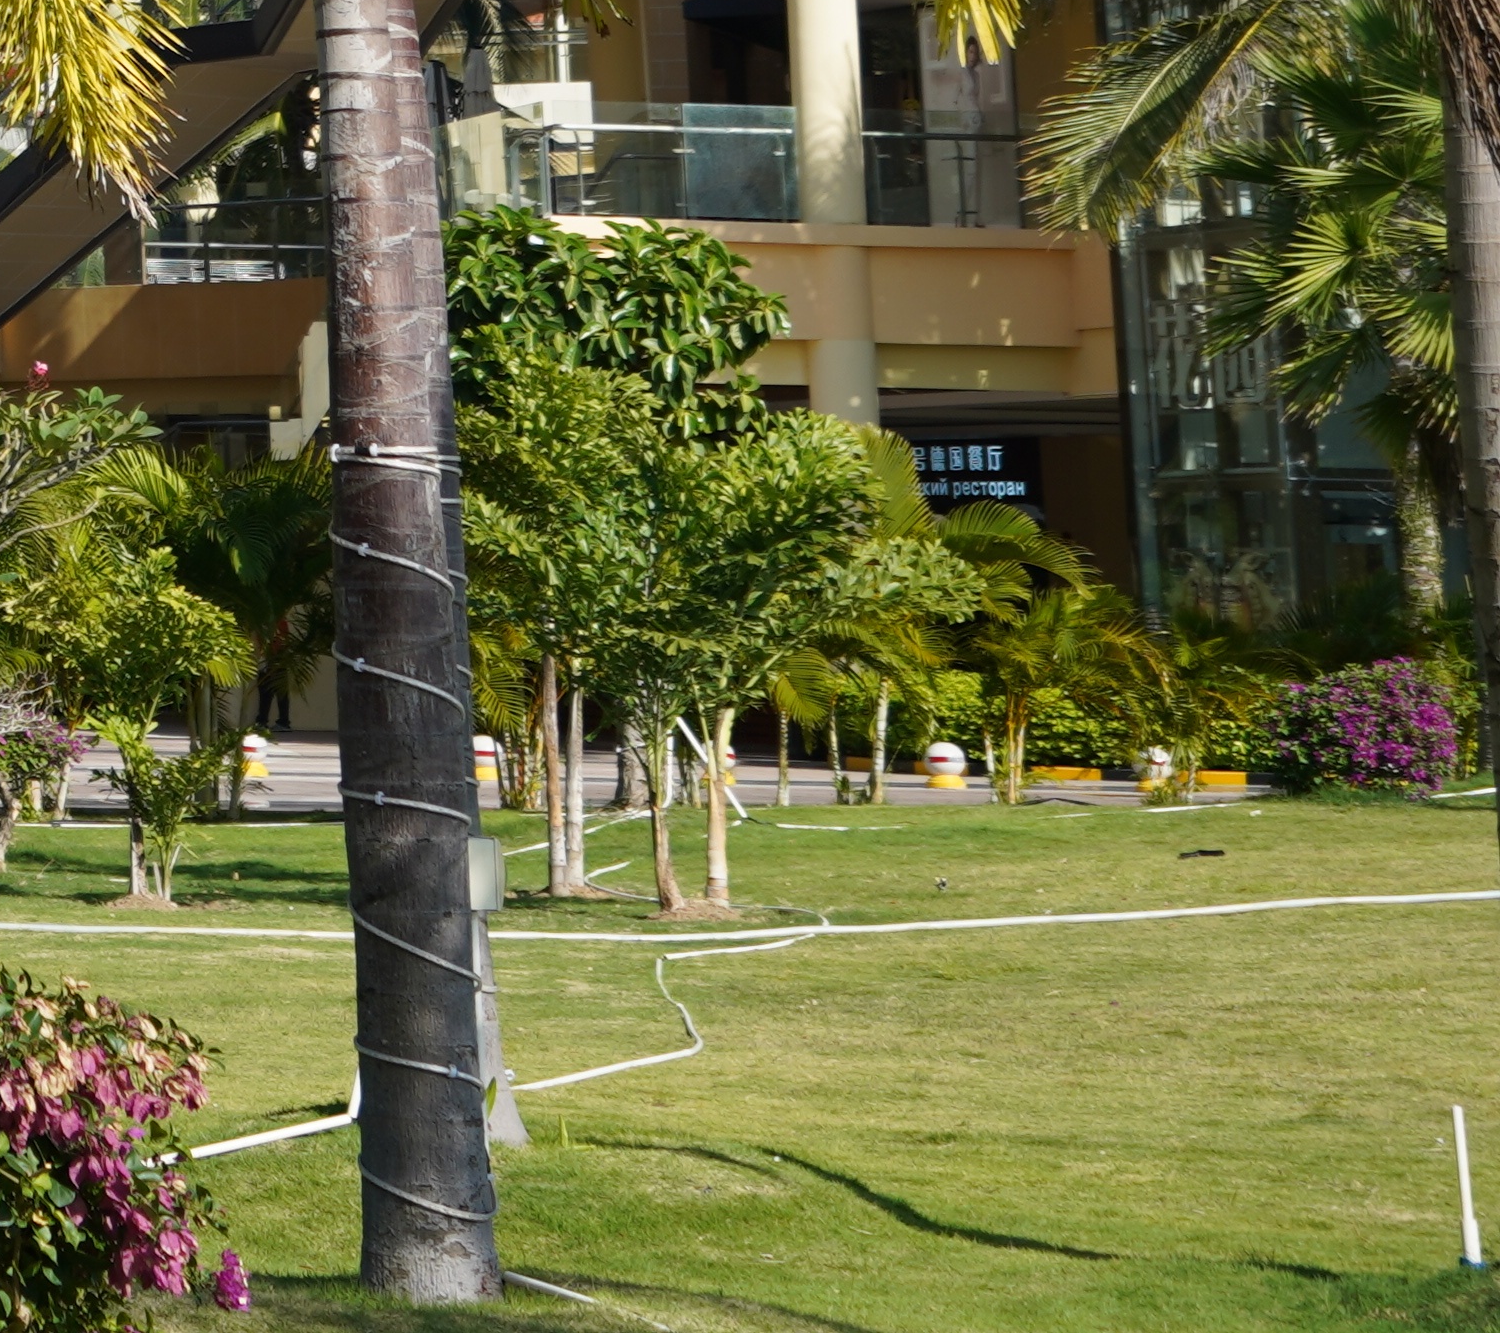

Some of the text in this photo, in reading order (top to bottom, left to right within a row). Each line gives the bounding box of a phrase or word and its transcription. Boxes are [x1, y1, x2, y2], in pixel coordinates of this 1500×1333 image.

[912, 445, 1004, 472] 号德国餐厅
[920, 478, 1026, 500] кий ресторан
